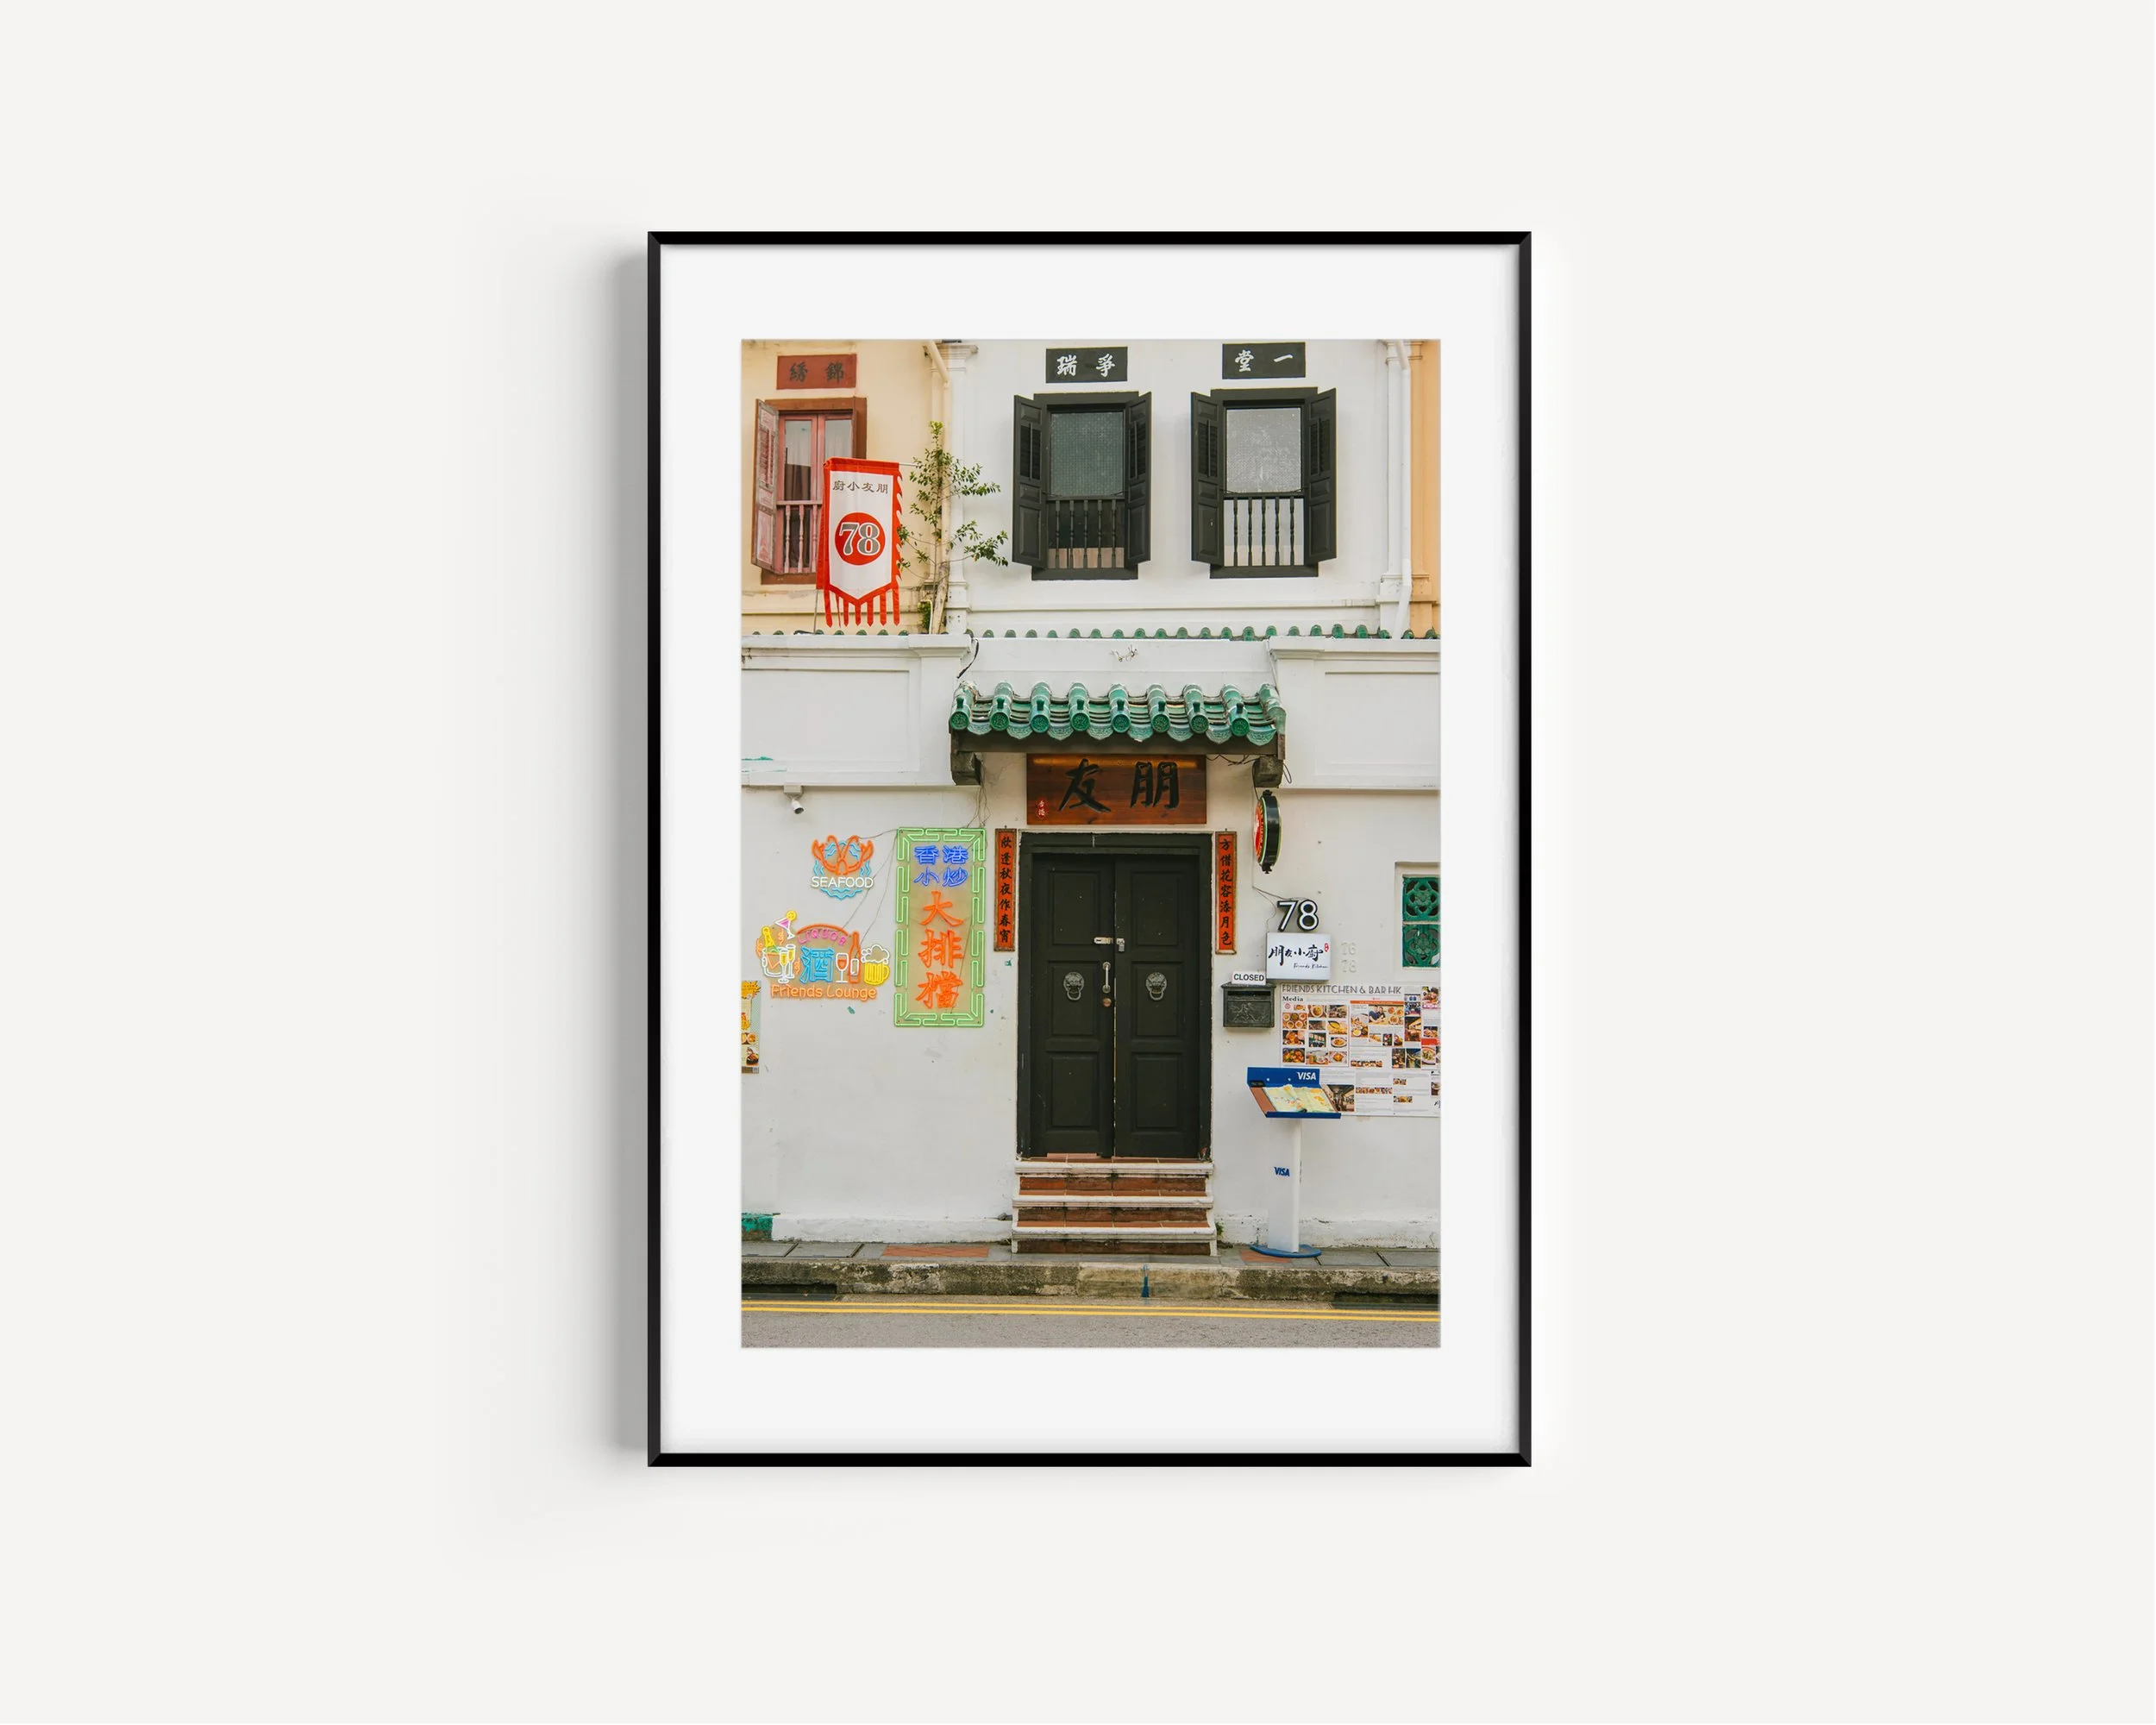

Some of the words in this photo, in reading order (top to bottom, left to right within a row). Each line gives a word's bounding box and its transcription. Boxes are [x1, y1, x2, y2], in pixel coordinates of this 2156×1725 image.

[838, 522, 880, 555] 78
[1058, 758, 1180, 812] 朋友
[914, 845, 968, 865] 香港
[811, 875, 874, 889] SEAFOOD
[913, 867, 968, 887] 小炒
[1277, 899, 1319, 932] 78
[798, 929, 847, 945] LIQUOR
[800, 946, 835, 983] 酒
[771, 984, 823, 998] Friends
[826, 984, 877, 1001] Lounge
[1282, 984, 1314, 993] FRIENDS
[1317, 985, 1357, 994] KITCHEN
[1359, 985, 1366, 994] &
[1369, 986, 1386, 994] BAR
[1388, 986, 1402, 994] HK
[1274, 1166, 1290, 1176] VISA
